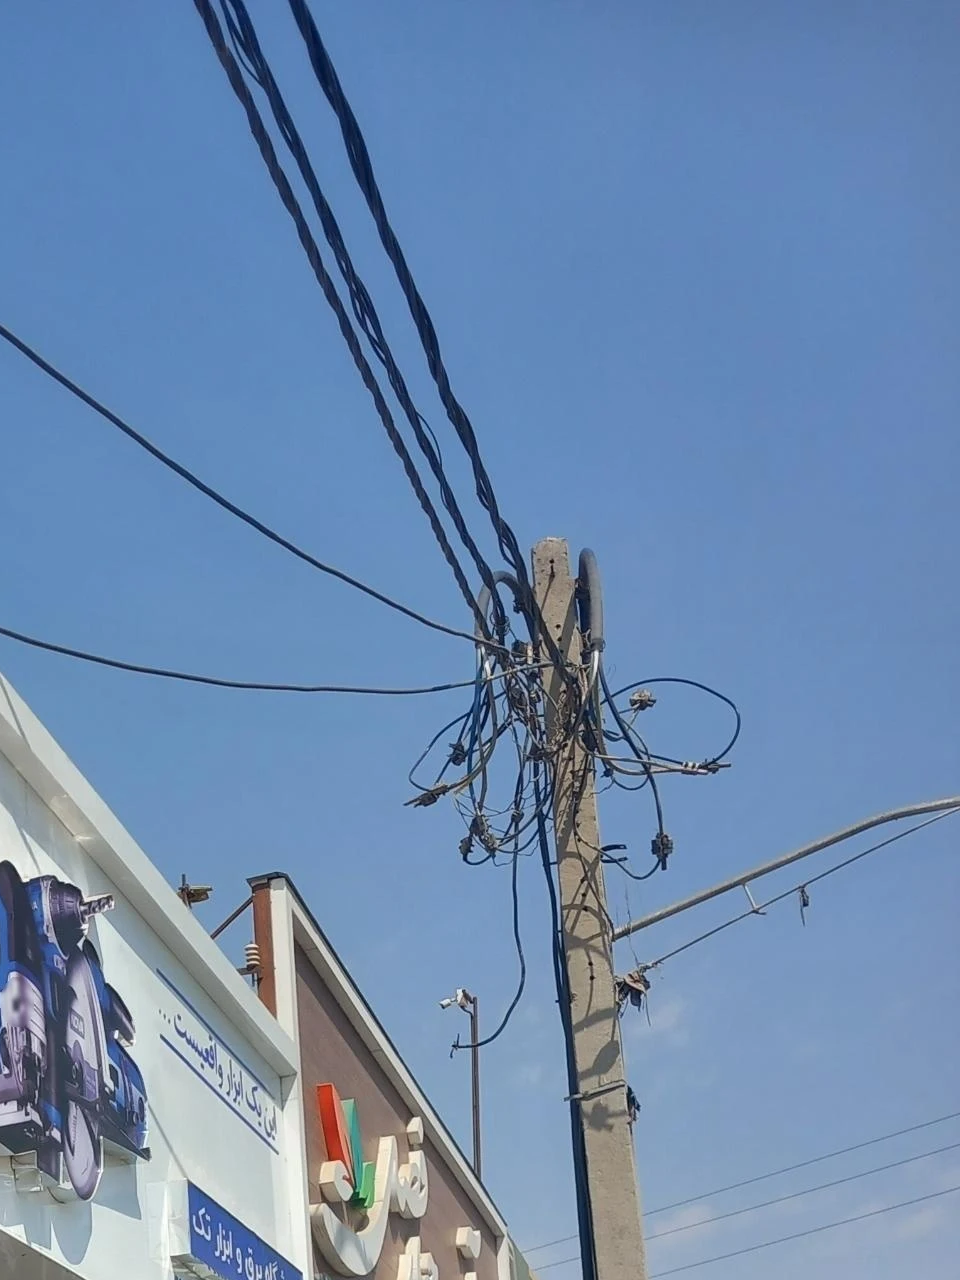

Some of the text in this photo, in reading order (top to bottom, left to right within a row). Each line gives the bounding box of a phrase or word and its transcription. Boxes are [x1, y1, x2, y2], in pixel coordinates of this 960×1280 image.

[225, 1060, 244, 1106] ابزار
[246, 1085, 262, 1127] یک
[263, 1104, 278, 1140] این
[192, 1207, 212, 1242] تک
[214, 1221, 234, 1265] ابزار
[236, 1247, 243, 1274] و
